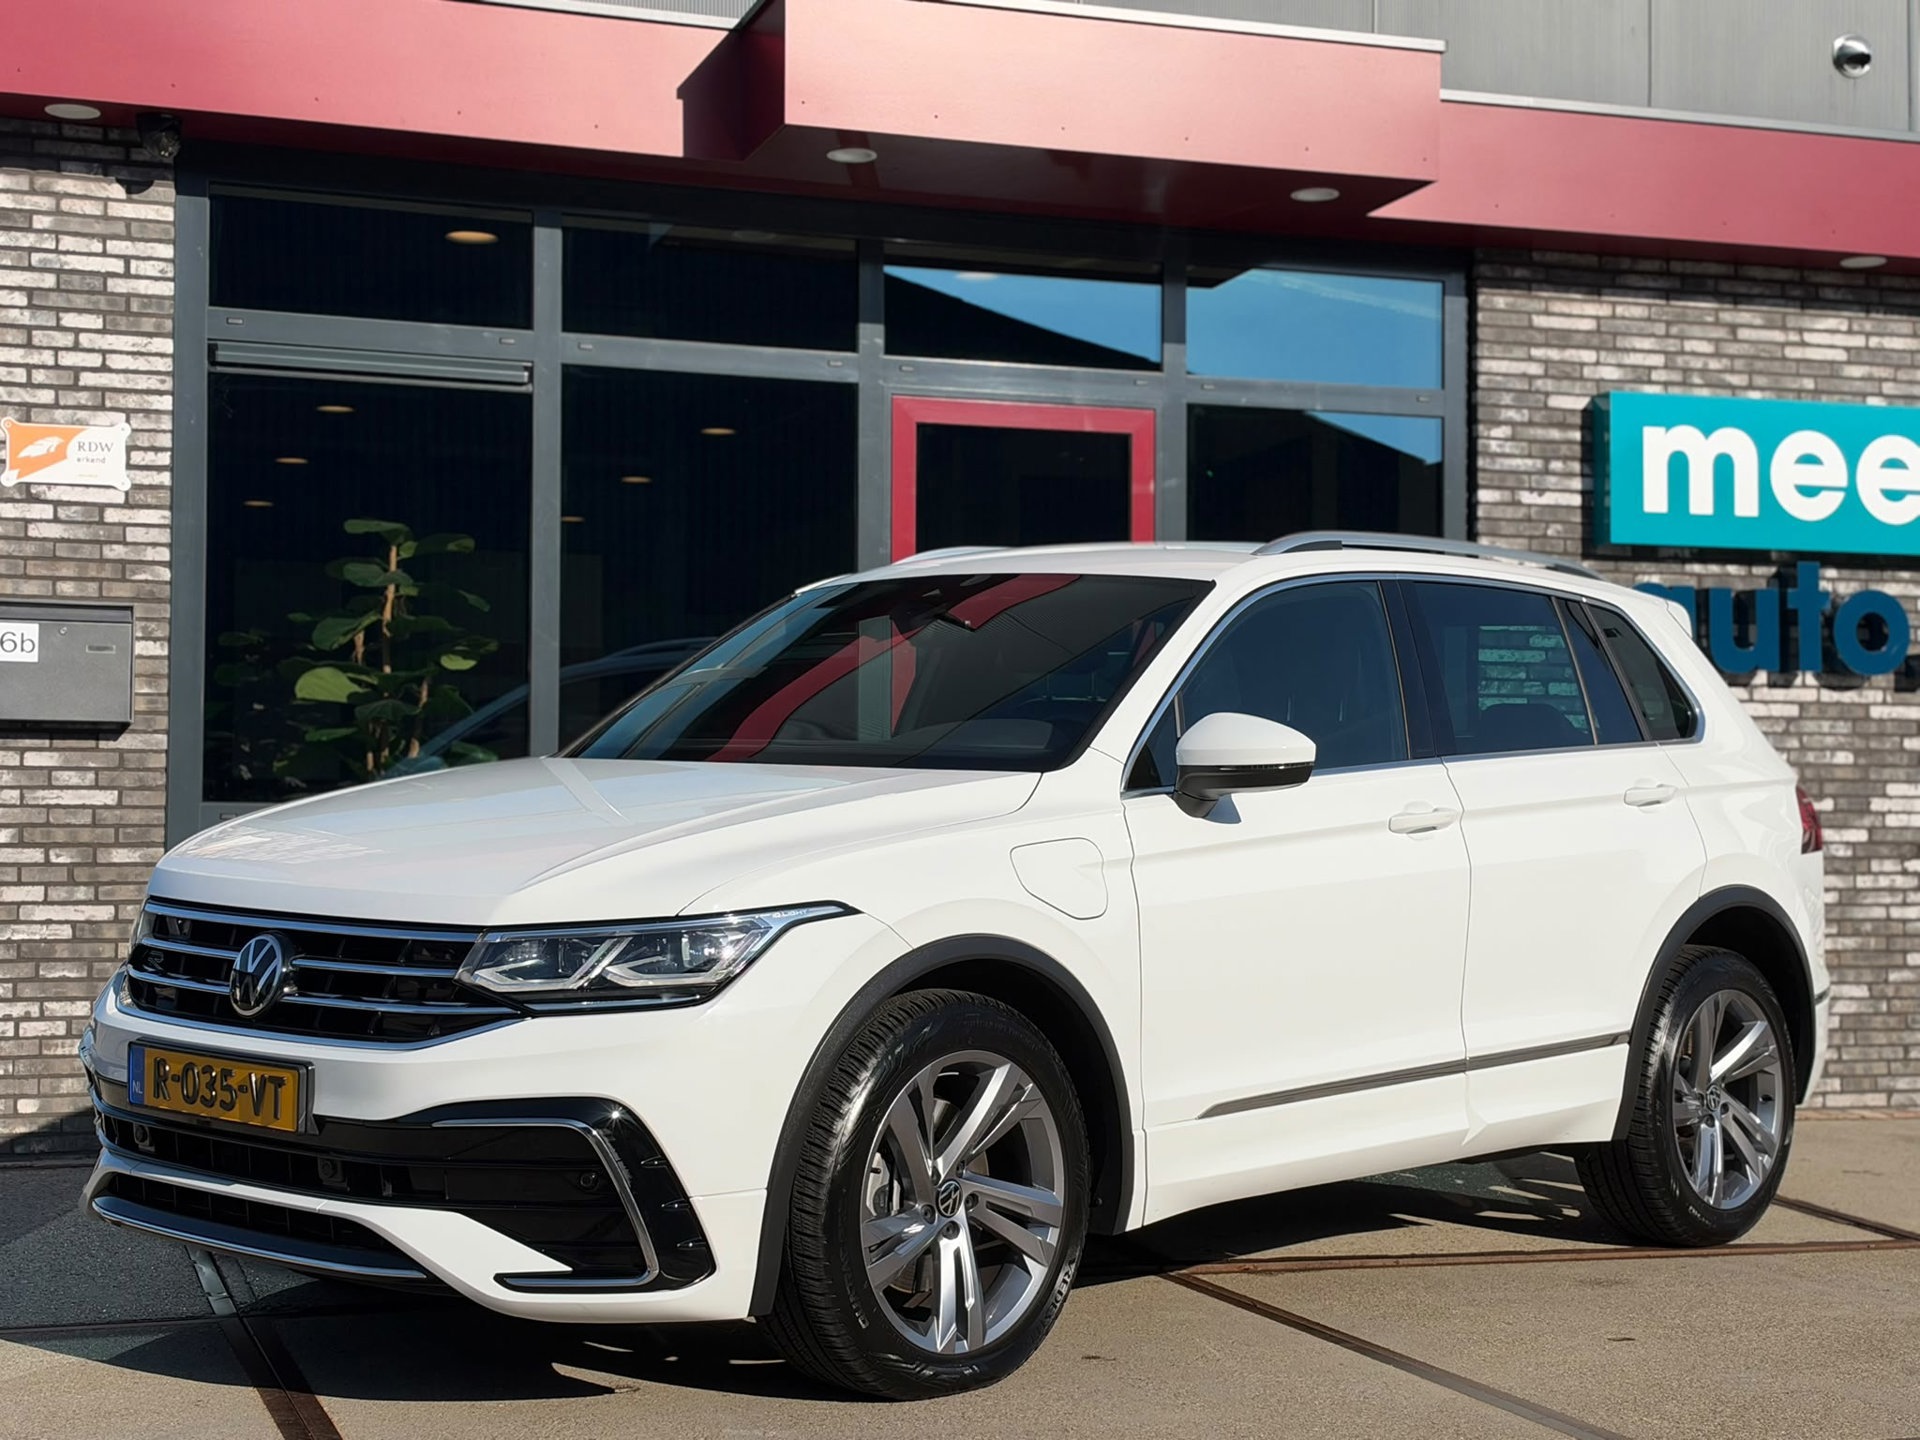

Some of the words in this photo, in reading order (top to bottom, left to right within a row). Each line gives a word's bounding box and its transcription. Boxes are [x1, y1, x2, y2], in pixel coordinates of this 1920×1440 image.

[77, 441, 114, 453] RDW
[1642, 424, 1920, 526] mee
[0, 631, 36, 653] 6b
[132, 1081, 143, 1095] NL
[153, 1056, 287, 1120] R-035-VT
